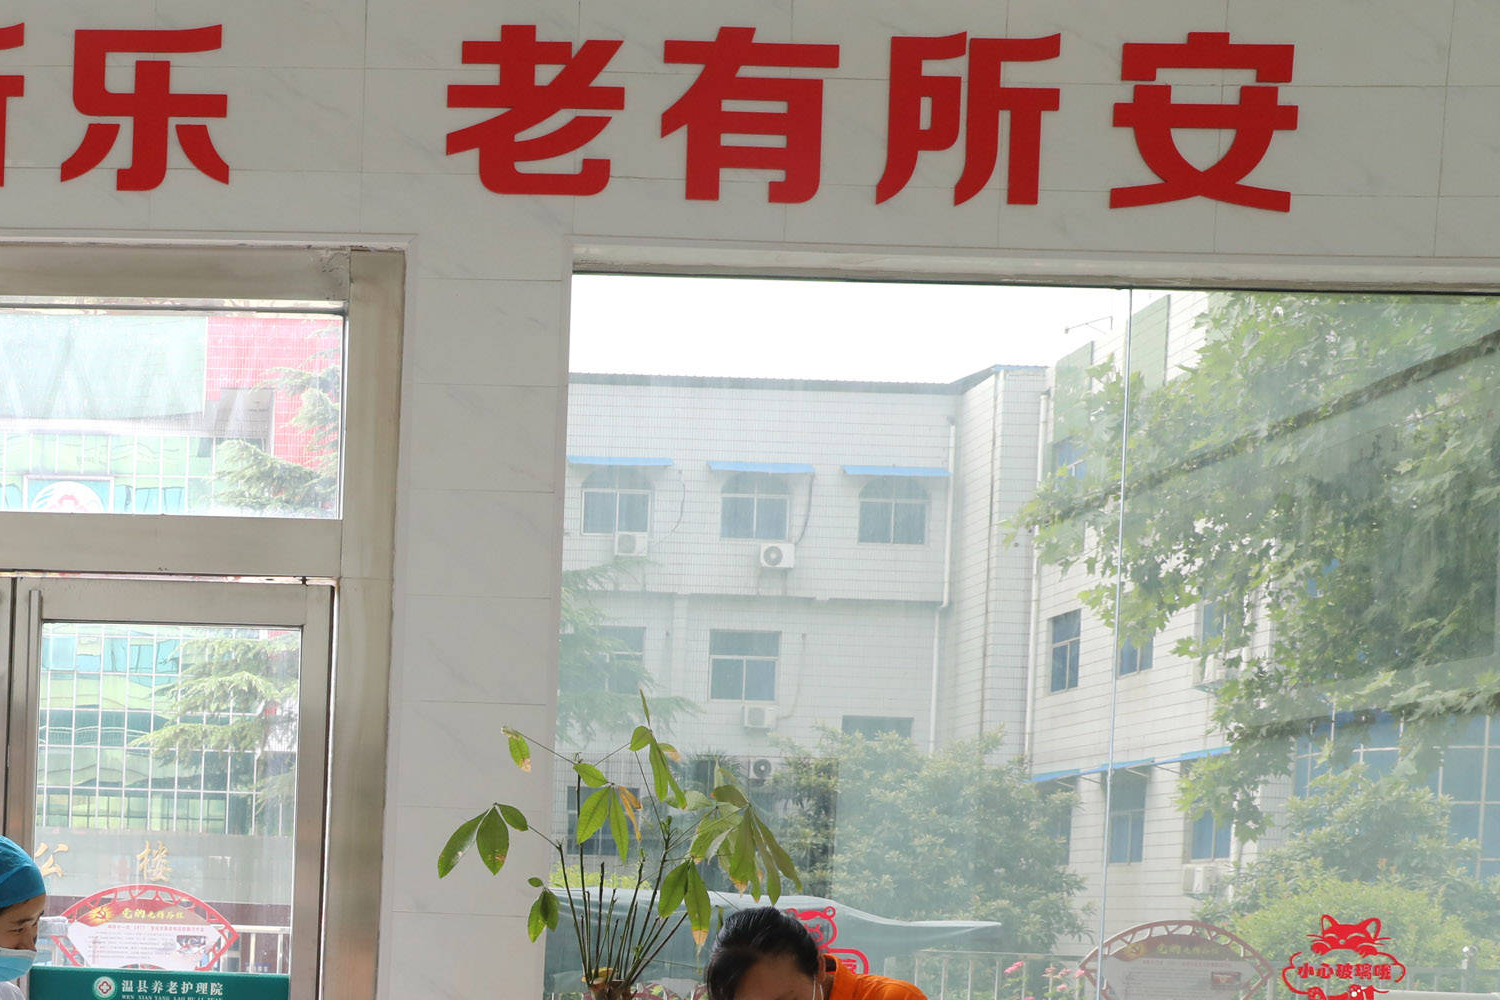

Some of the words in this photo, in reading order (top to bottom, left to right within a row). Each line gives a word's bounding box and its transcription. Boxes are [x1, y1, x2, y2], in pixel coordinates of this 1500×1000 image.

[445, 24, 1299, 213] 老有所安
[121, 979, 224, 996] 温县养老护理院
